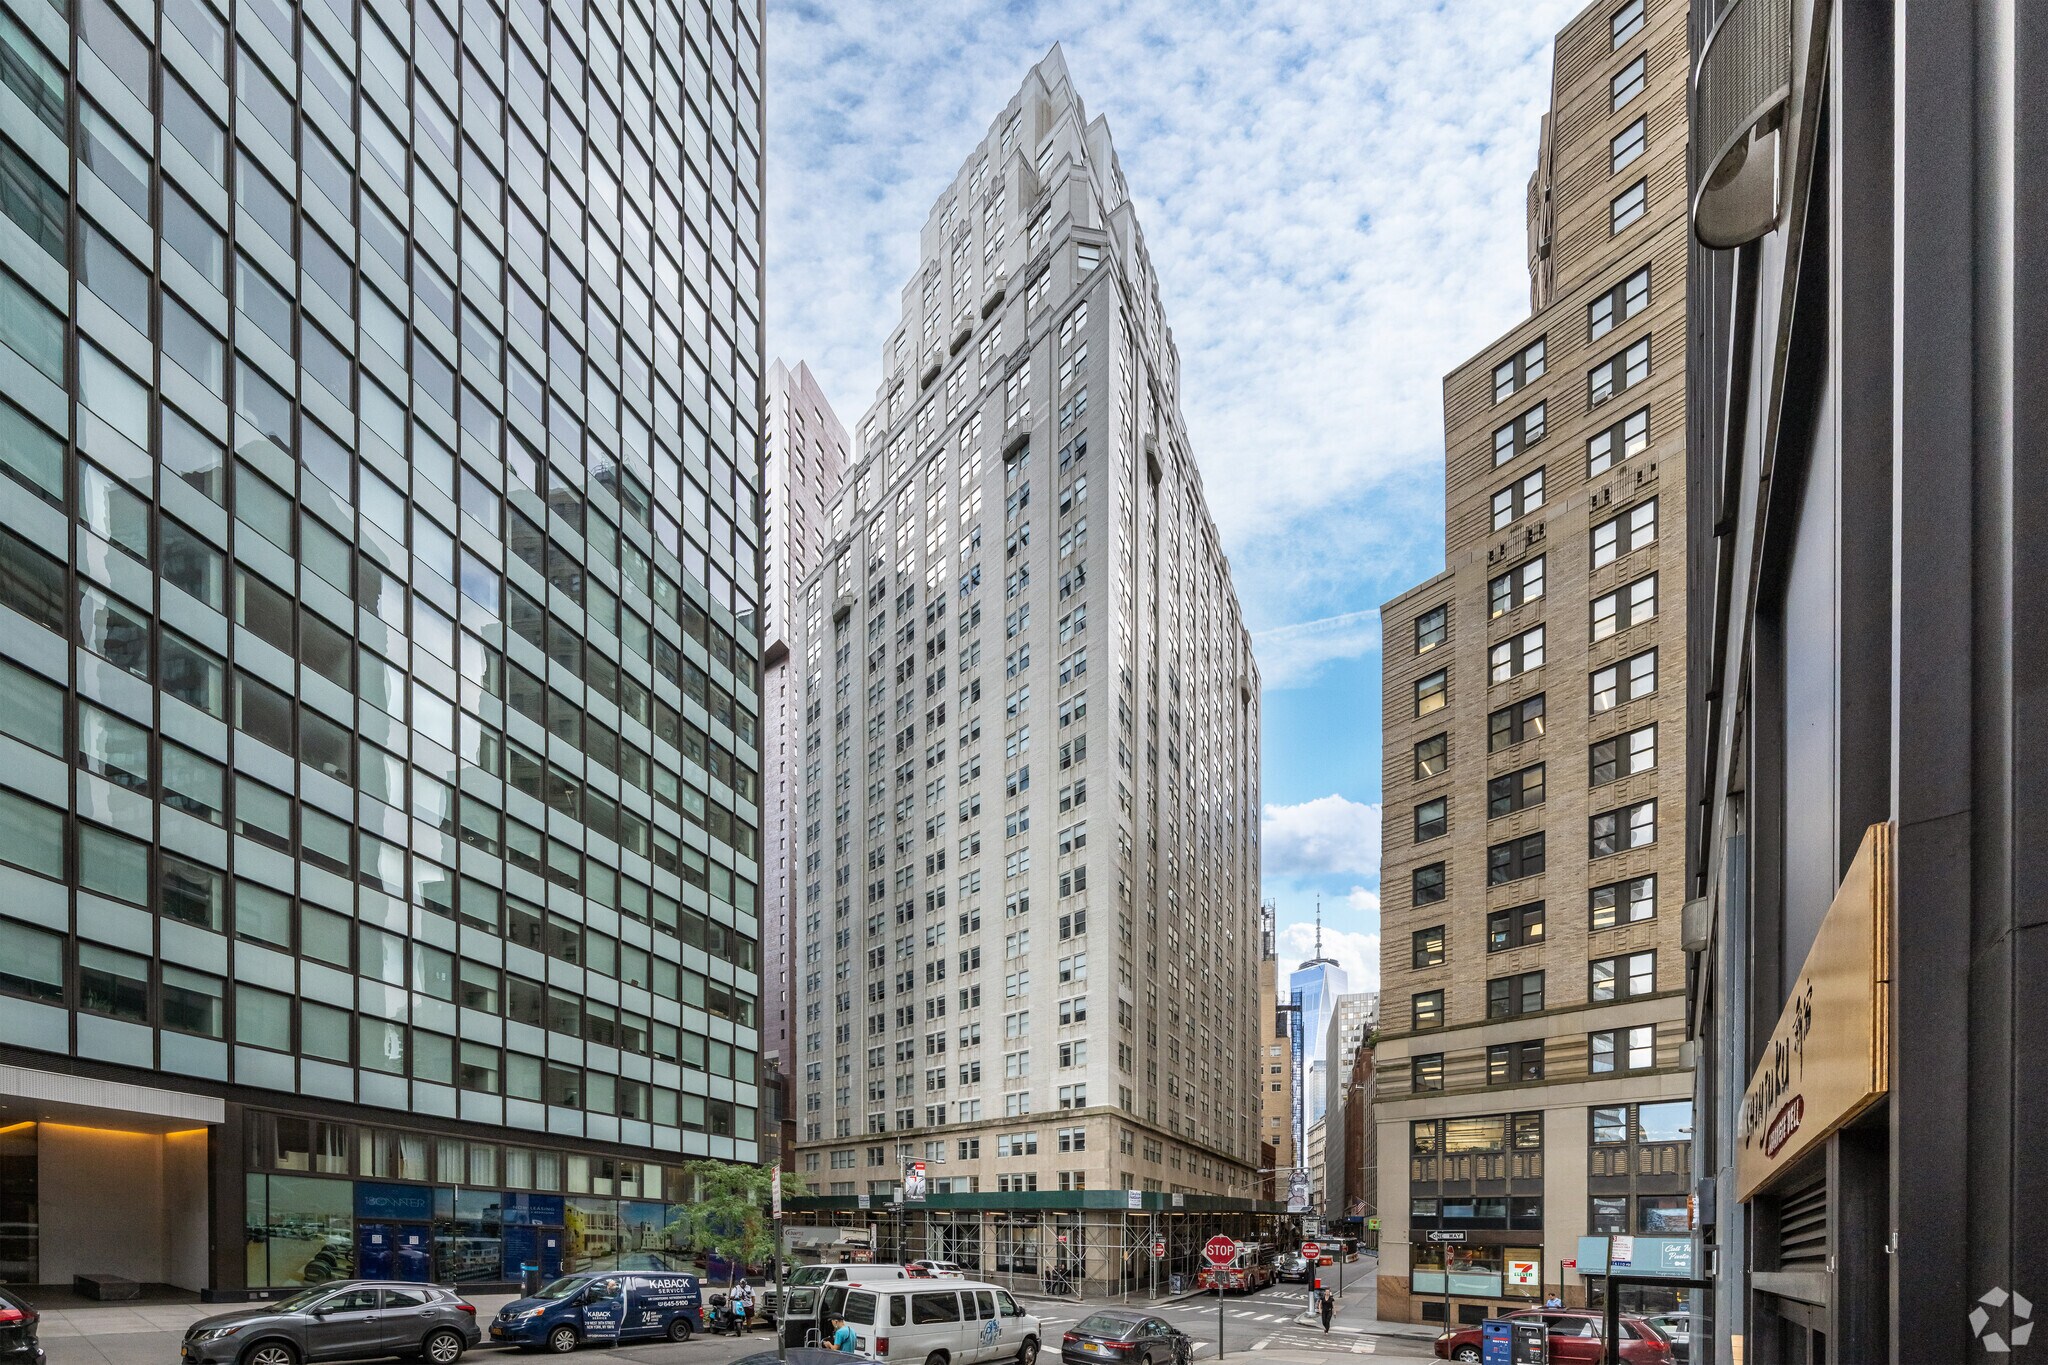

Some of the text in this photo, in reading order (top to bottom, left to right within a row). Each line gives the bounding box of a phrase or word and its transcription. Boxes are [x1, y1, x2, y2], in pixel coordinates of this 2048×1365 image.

[1207, 1244, 1234, 1256] STOP
[1514, 1263, 1533, 1282] 7
[649, 1278, 690, 1289] KABACK
[641, 1311, 651, 1323] 24
